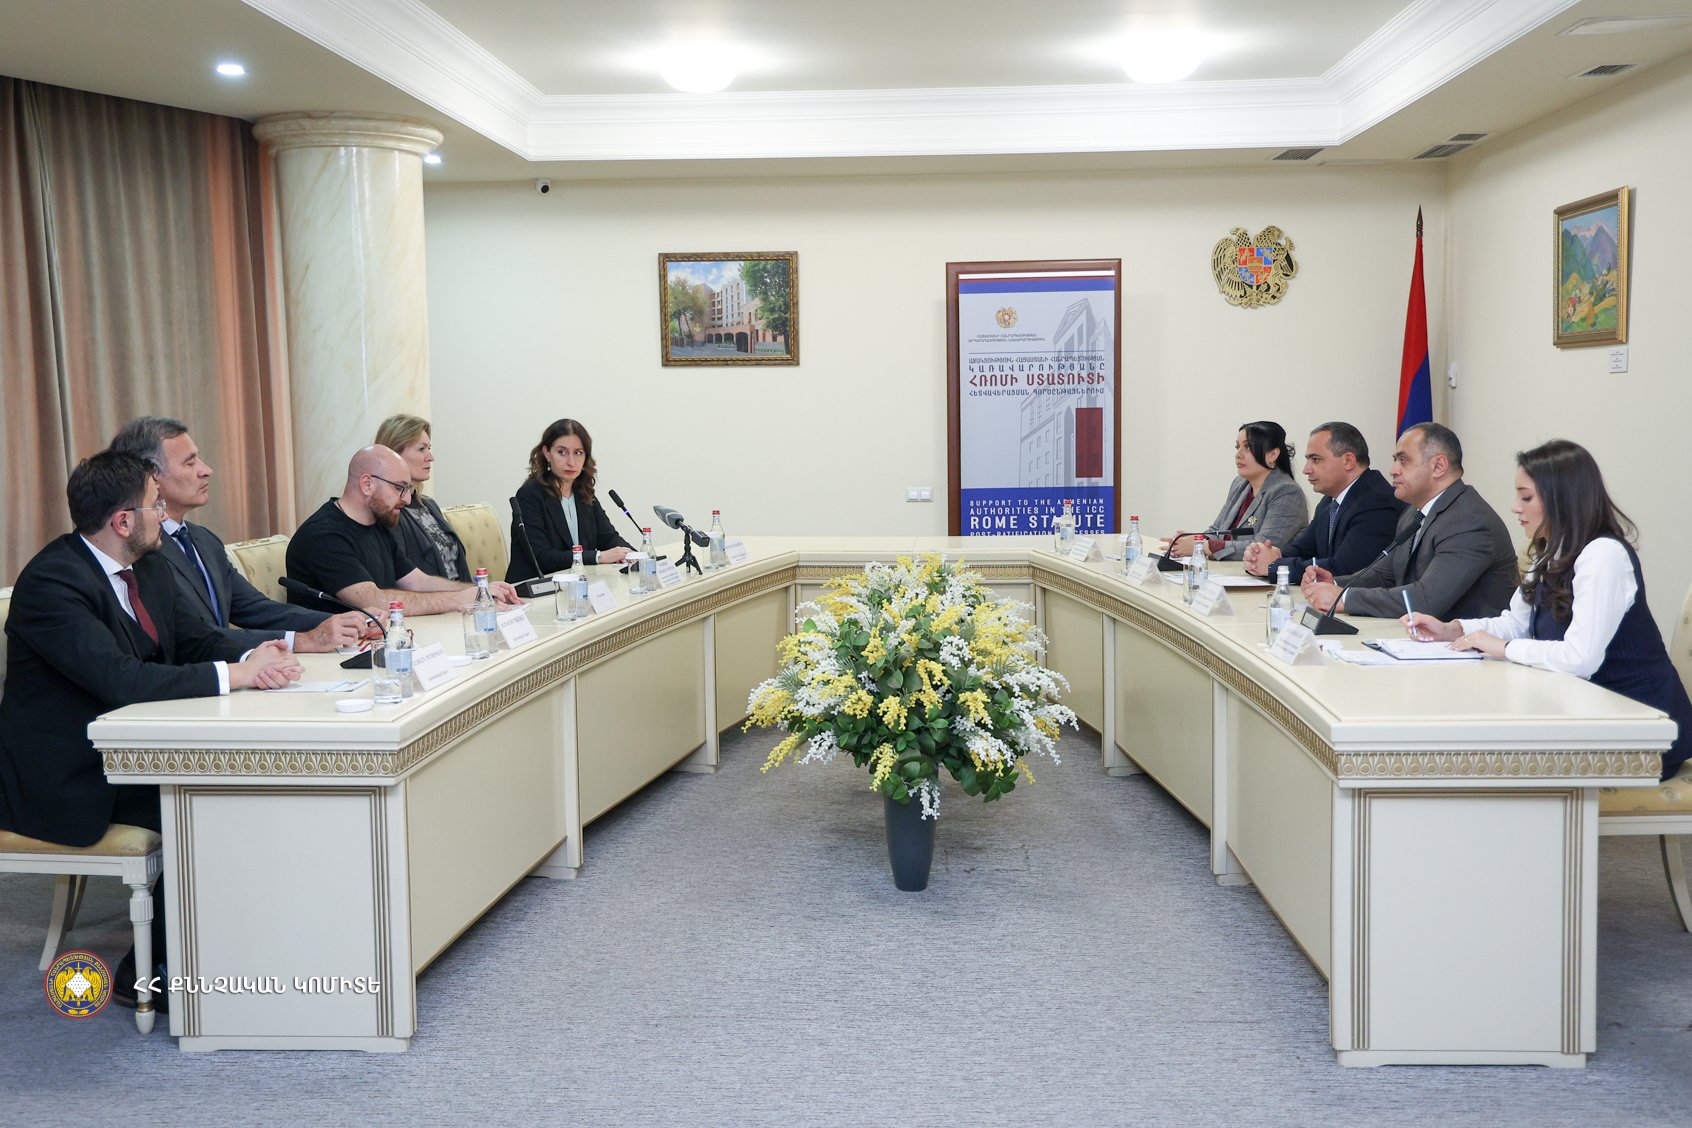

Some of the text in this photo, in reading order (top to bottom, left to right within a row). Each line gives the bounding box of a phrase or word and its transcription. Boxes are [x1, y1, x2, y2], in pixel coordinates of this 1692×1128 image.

[968, 362, 1105, 372] ԿԱՌԱՎԱՐՈՒԹՅԱՆԸ
[969, 372, 1105, 387] ՀՌՈՄԻ ՍՏԱՏՈՒՏԻ
[969, 499, 1011, 507] SUPPORT
[1034, 498, 1051, 506] THE
[969, 506, 1039, 516] AUTHORITIES
[1045, 506, 1056, 514] IN
[1087, 505, 1105, 514] ICC
[970, 515, 1018, 530] ROME
